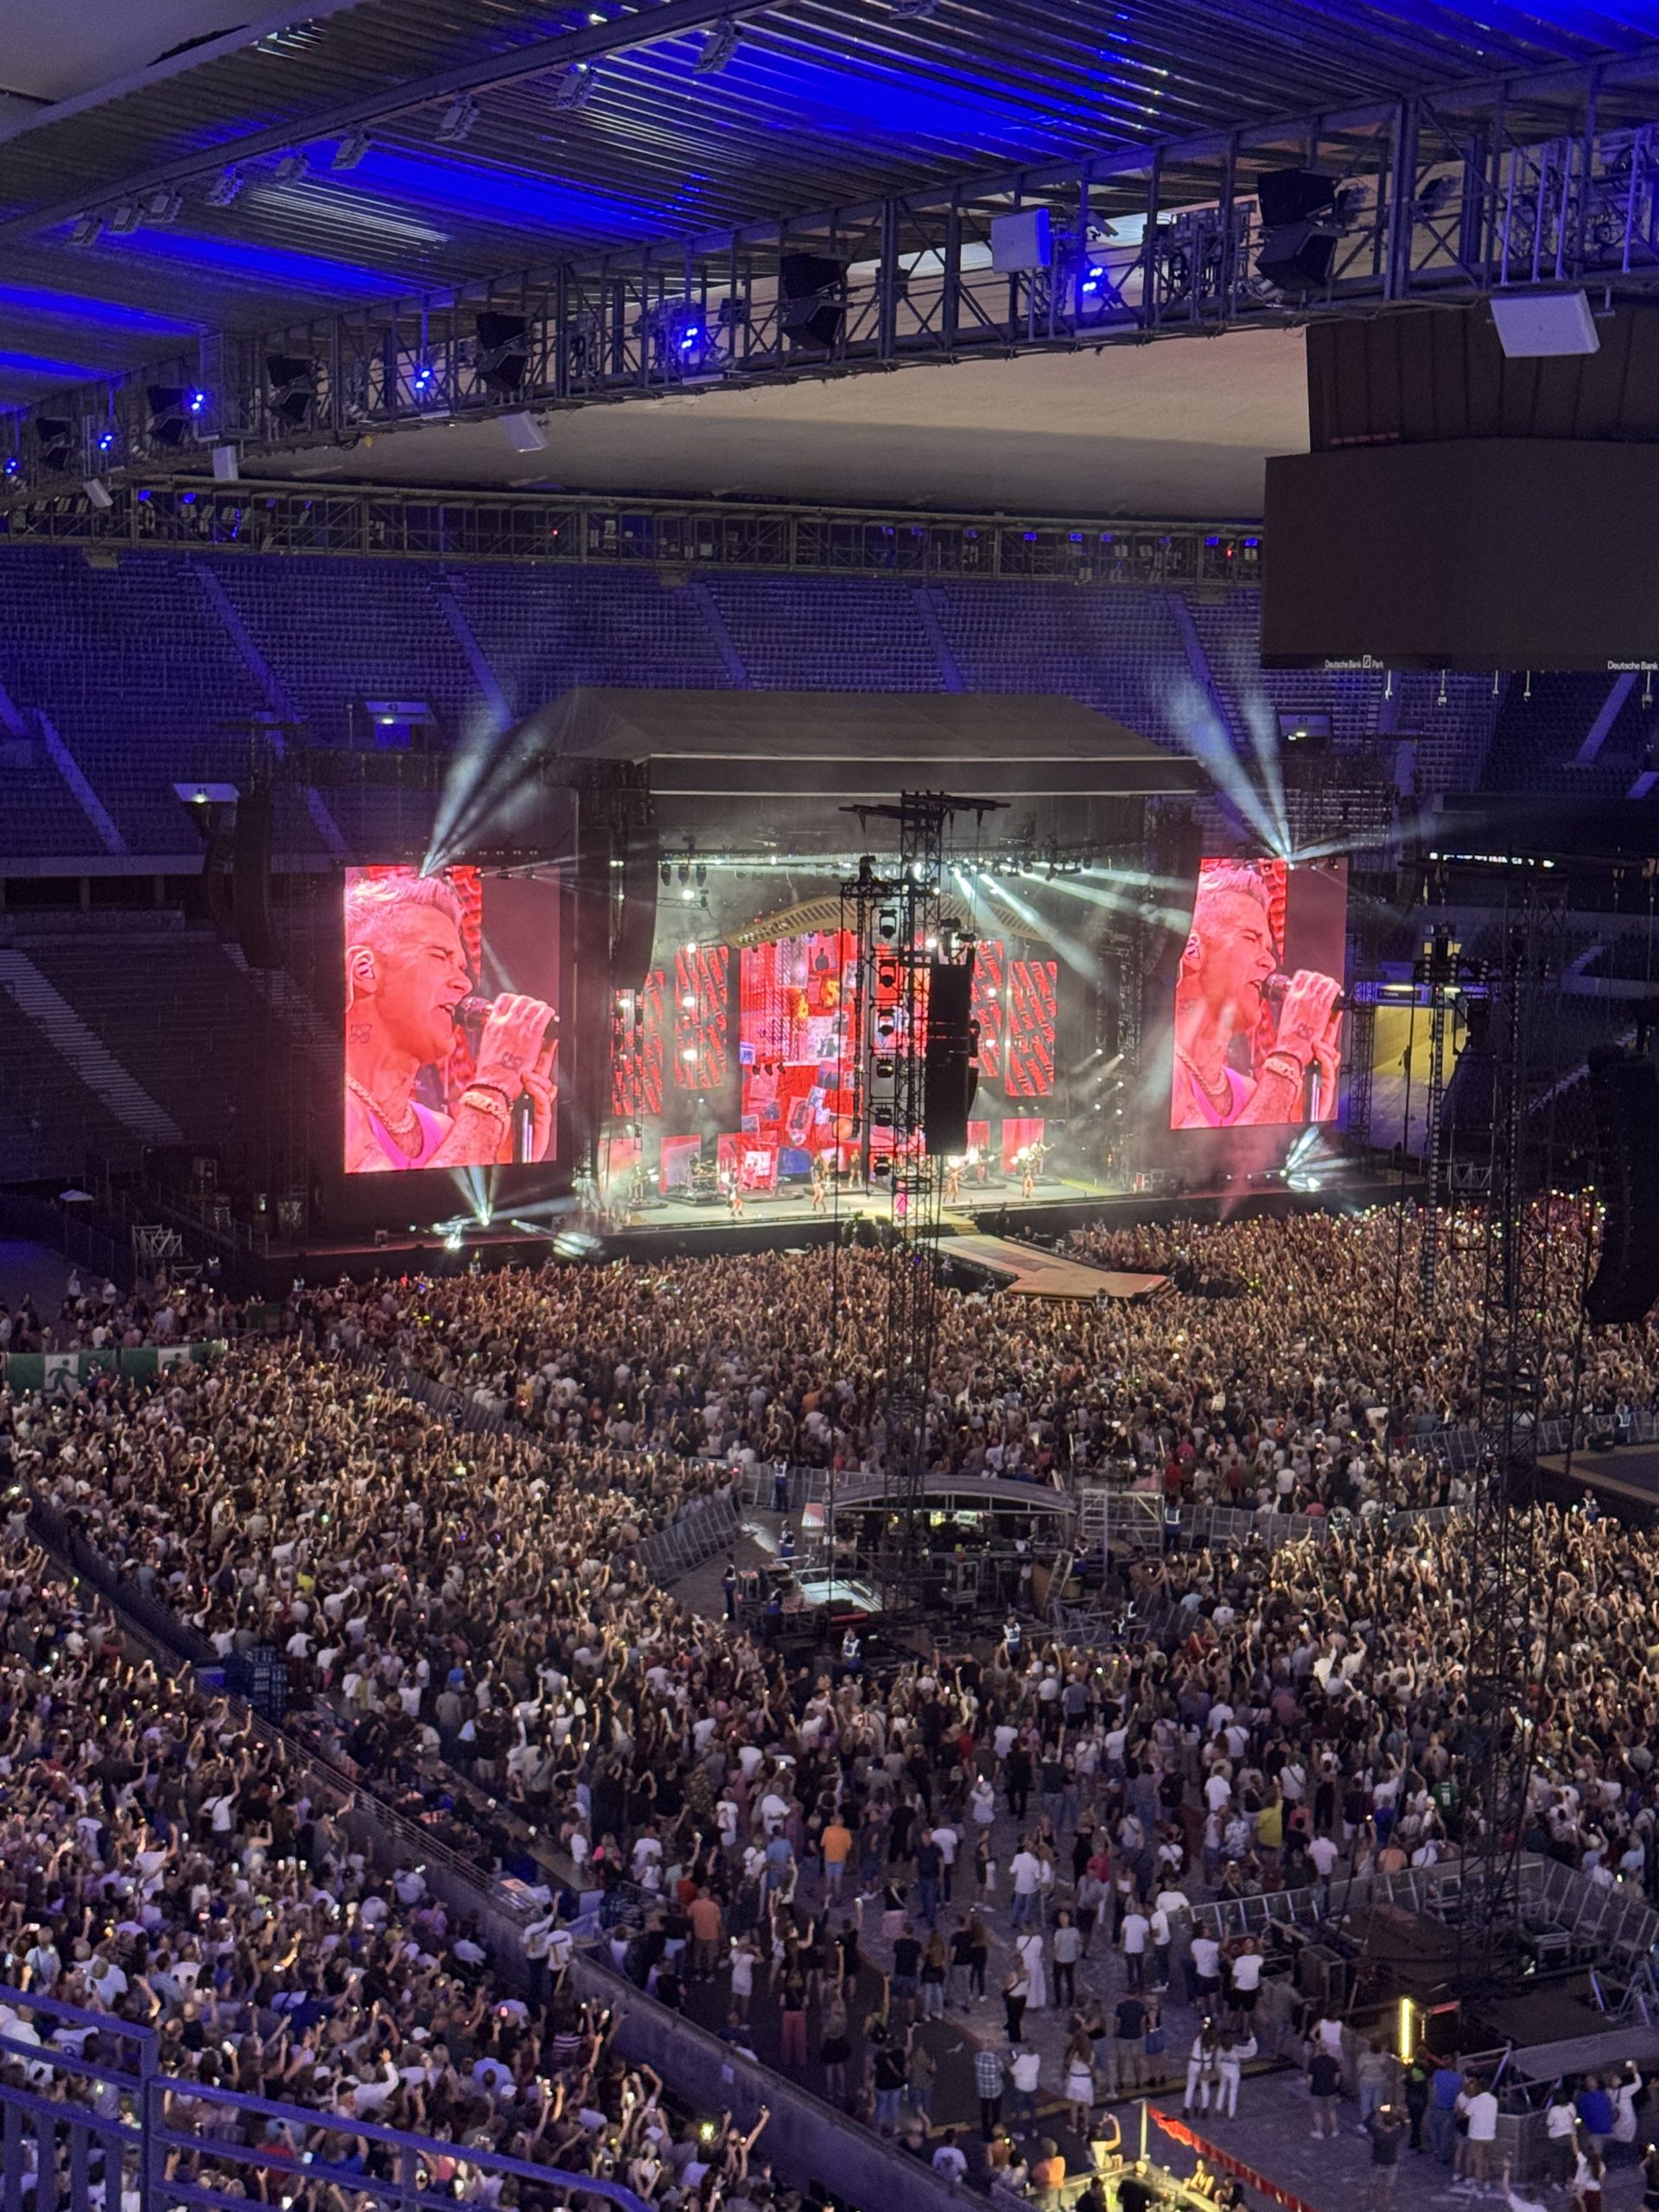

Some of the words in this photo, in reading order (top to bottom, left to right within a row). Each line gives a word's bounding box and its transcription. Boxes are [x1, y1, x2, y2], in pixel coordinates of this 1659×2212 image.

[1325, 659, 1348, 669] Deutsche
[1349, 659, 1362, 669] Bank
[1372, 659, 1384, 669] Park
[1607, 660, 1640, 671] Deutsche
[1641, 660, 1659, 671] Bank
